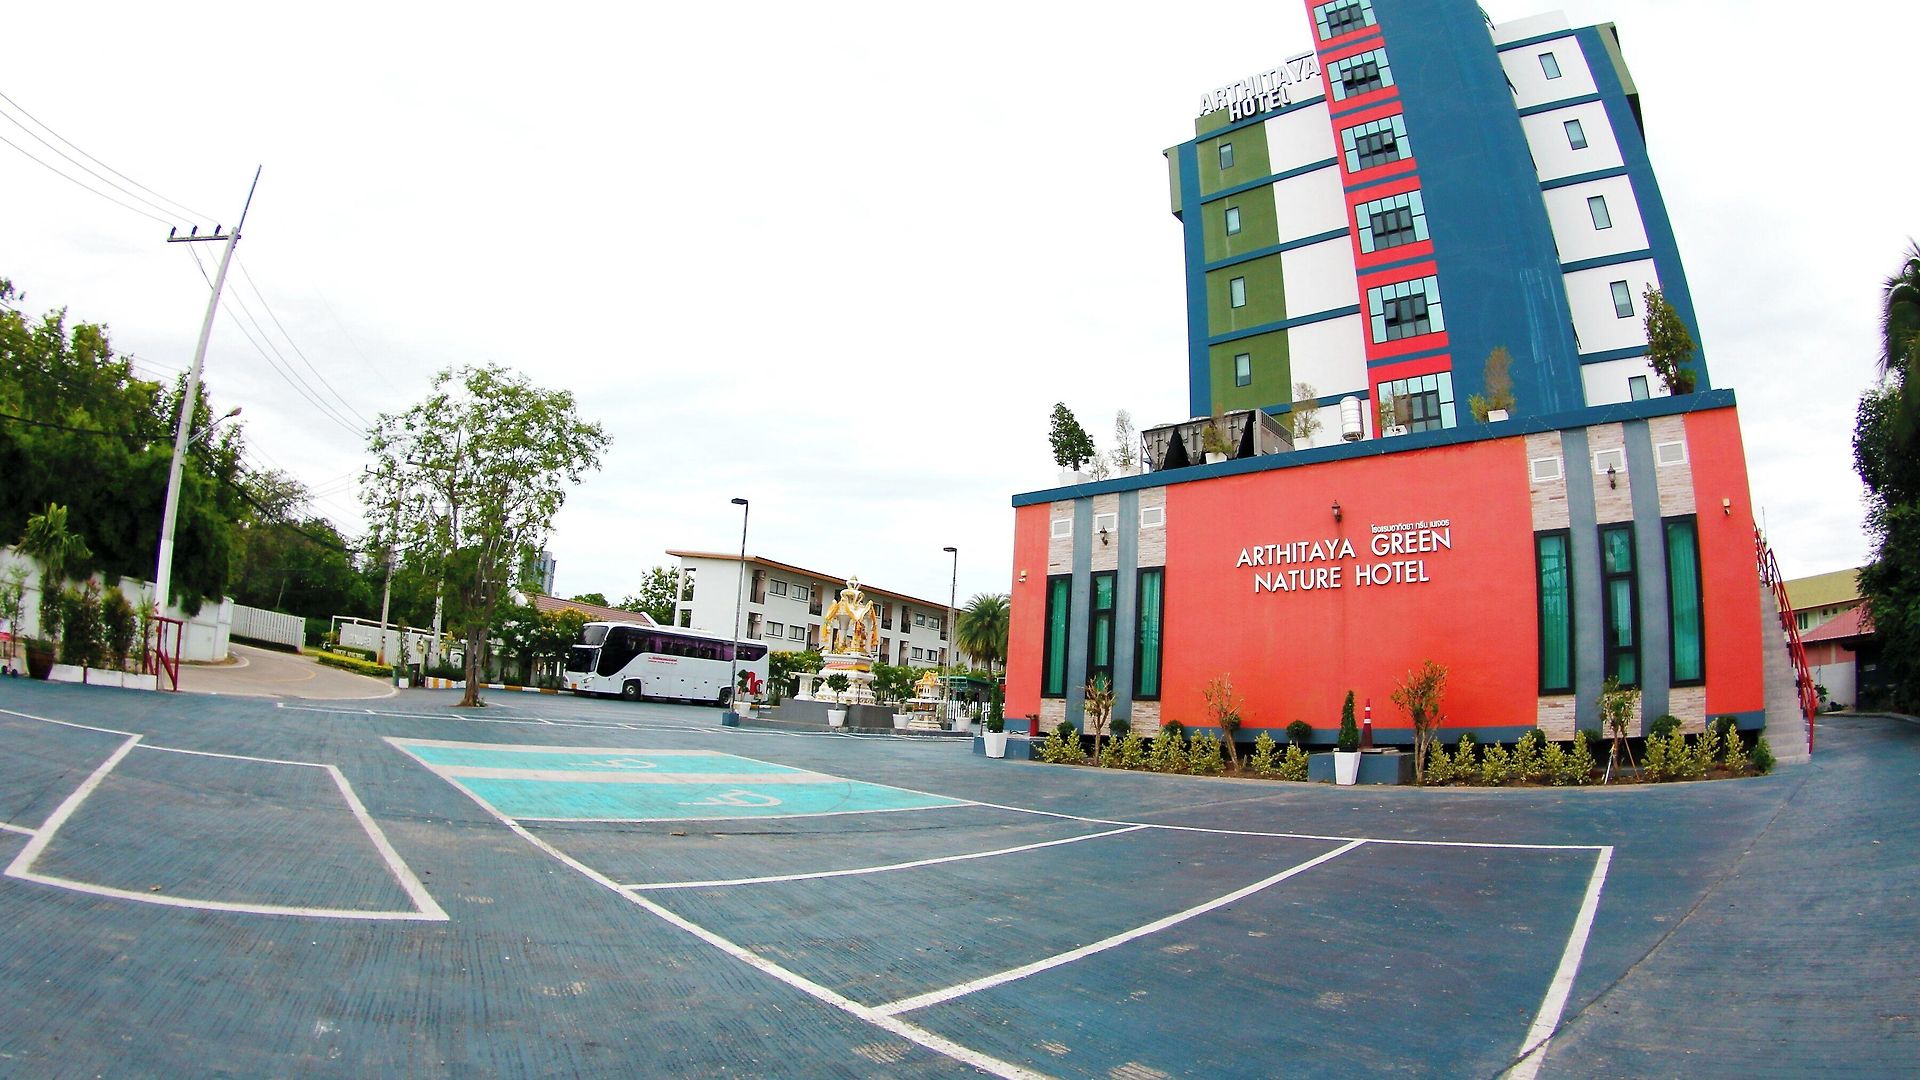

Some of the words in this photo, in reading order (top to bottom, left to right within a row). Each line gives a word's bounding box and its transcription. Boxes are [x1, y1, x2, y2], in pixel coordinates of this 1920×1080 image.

[1200, 56, 1322, 116] ARTHITAYA
[1228, 86, 1292, 122] HOTEL
[1236, 538, 1356, 568] ARTHITAYA
[1370, 528, 1452, 556] GREEN
[1254, 566, 1342, 593] NATURE
[1355, 560, 1430, 586] HOTEL
